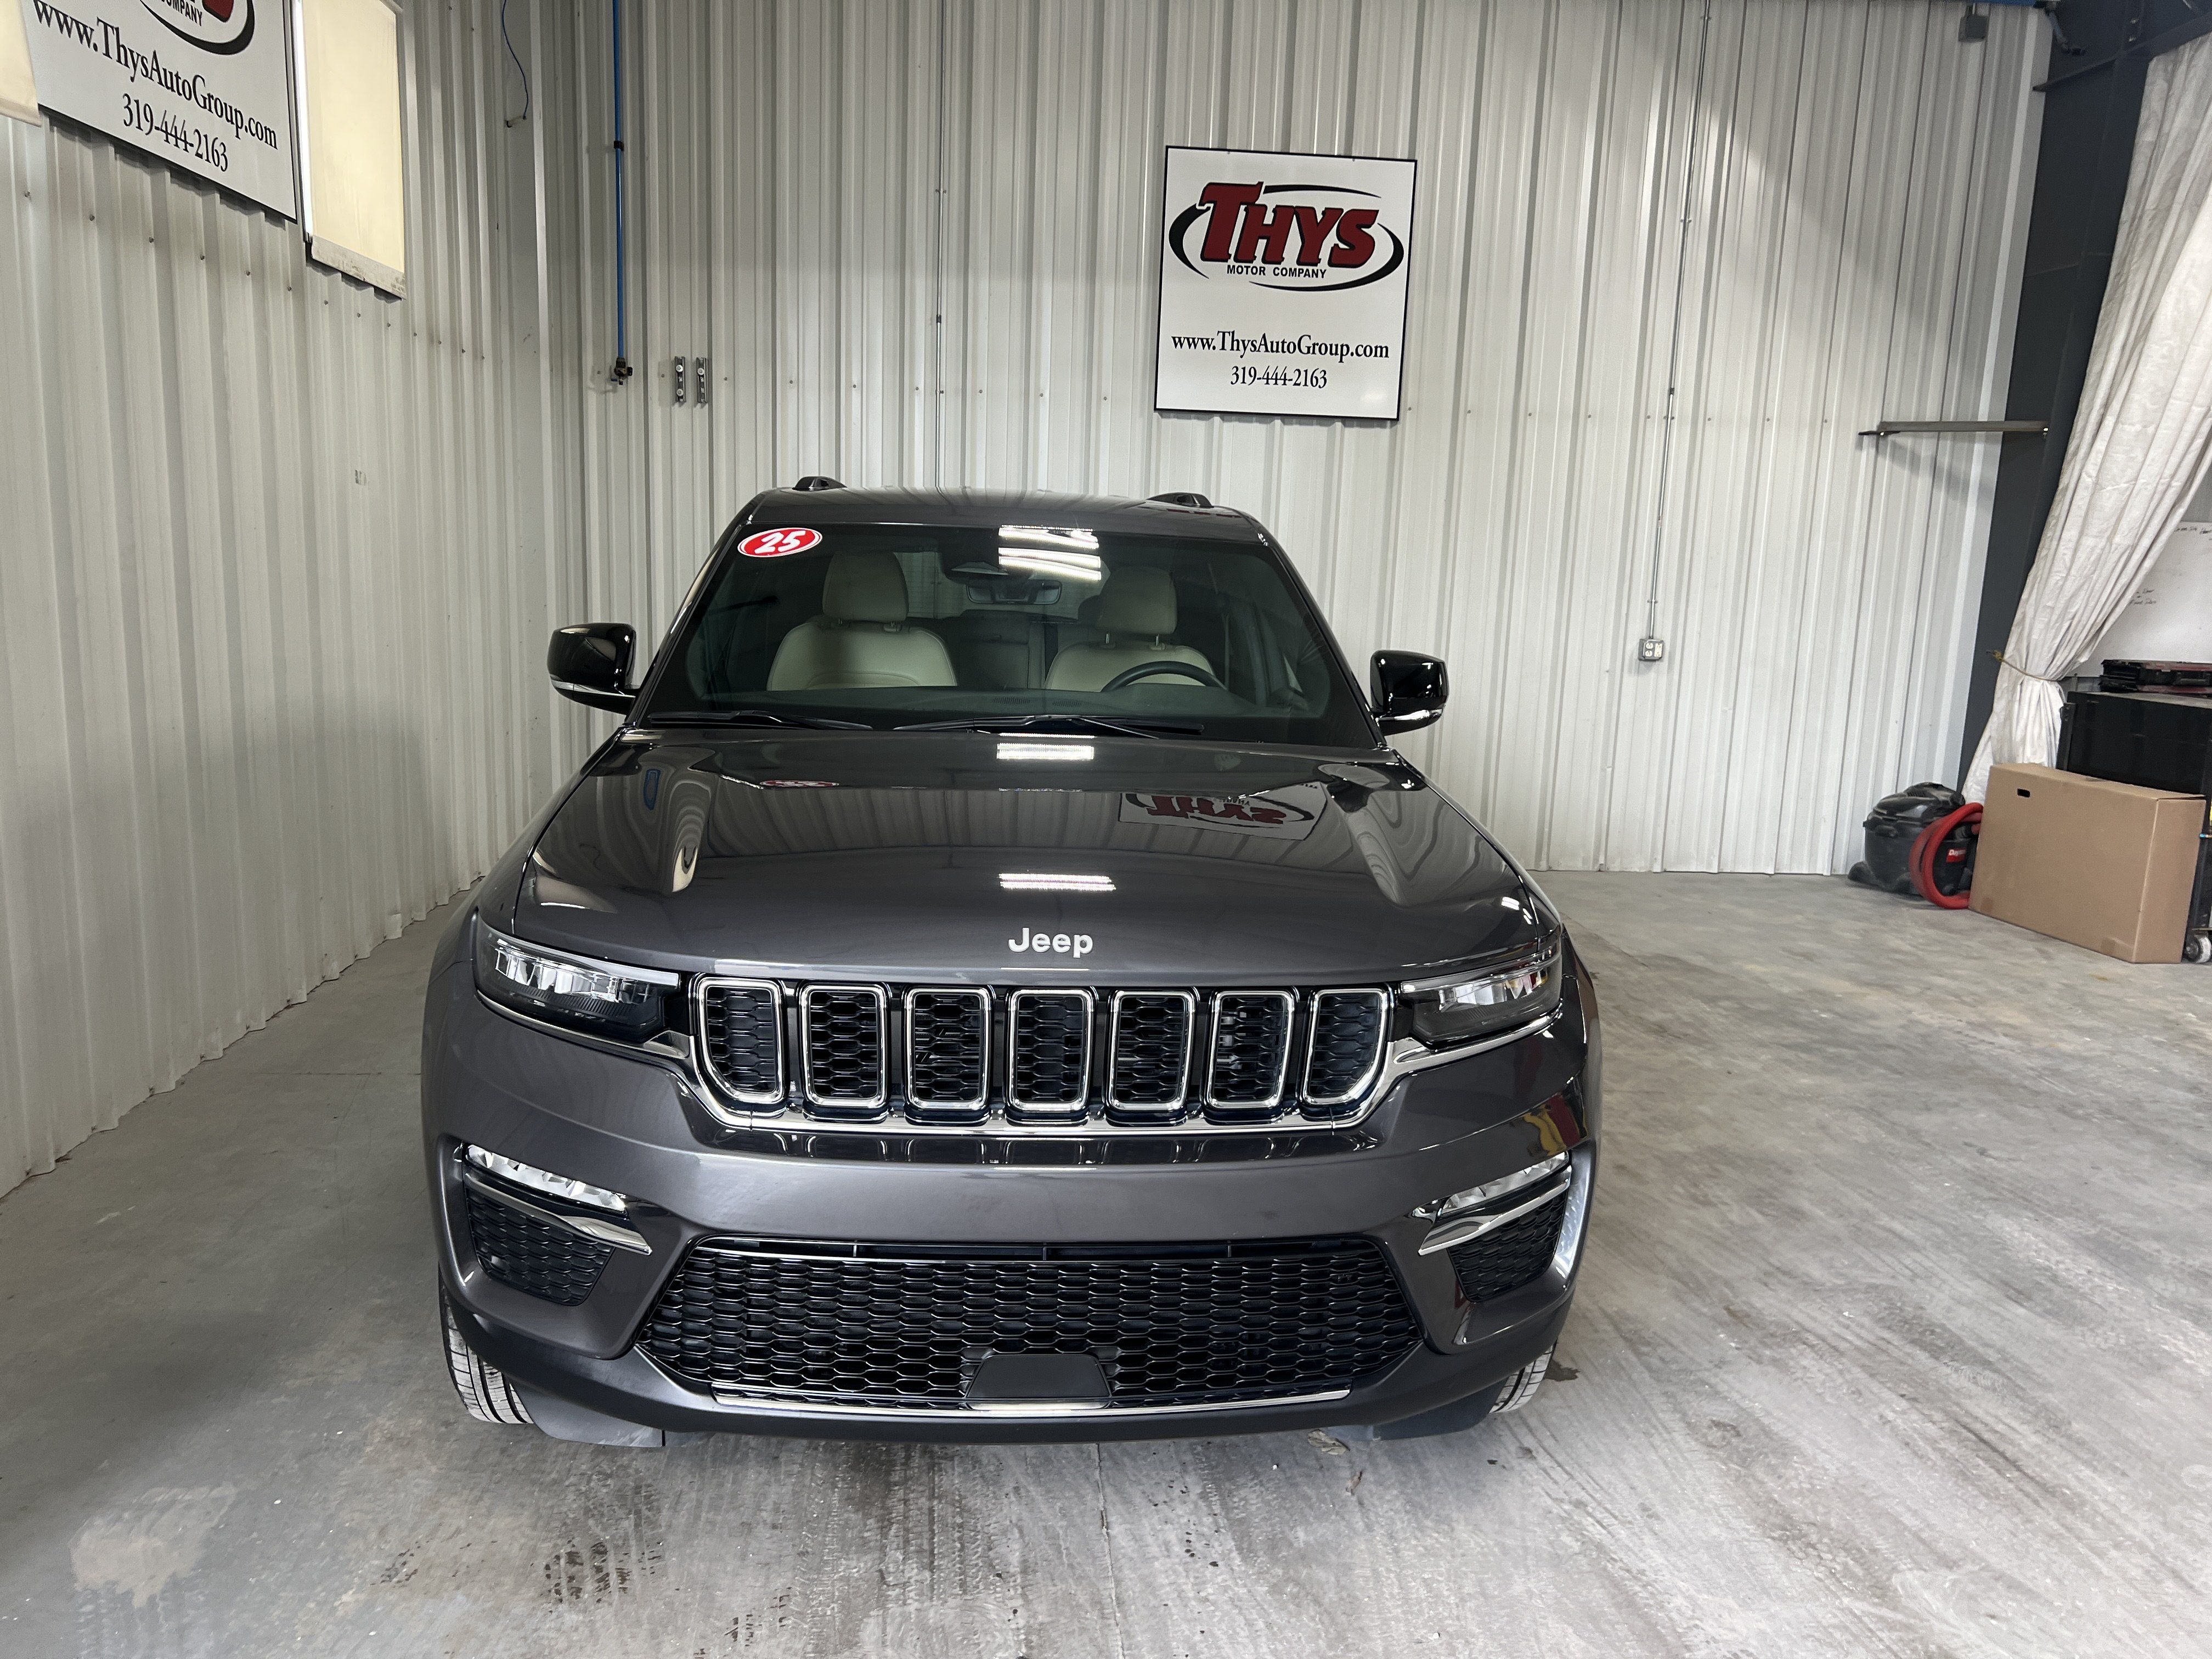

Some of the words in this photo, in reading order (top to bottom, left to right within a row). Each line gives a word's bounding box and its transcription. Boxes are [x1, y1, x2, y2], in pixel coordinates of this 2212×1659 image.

[162, 0, 202, 27] MPANY
[33, 0, 278, 150] www.ThysAutoGroup.com
[122, 93, 229, 172] 319-444-2163
[1198, 181, 1380, 268] THYS
[1227, 264, 1266, 276] MOTOR
[1272, 267, 1327, 279] COMPANY
[1171, 330, 1390, 363] www.ThysAutoGroup.com
[1230, 365, 1328, 388] 319-444-2163
[754, 530, 806, 554] 25
[1008, 927, 1093, 958] Jeep
